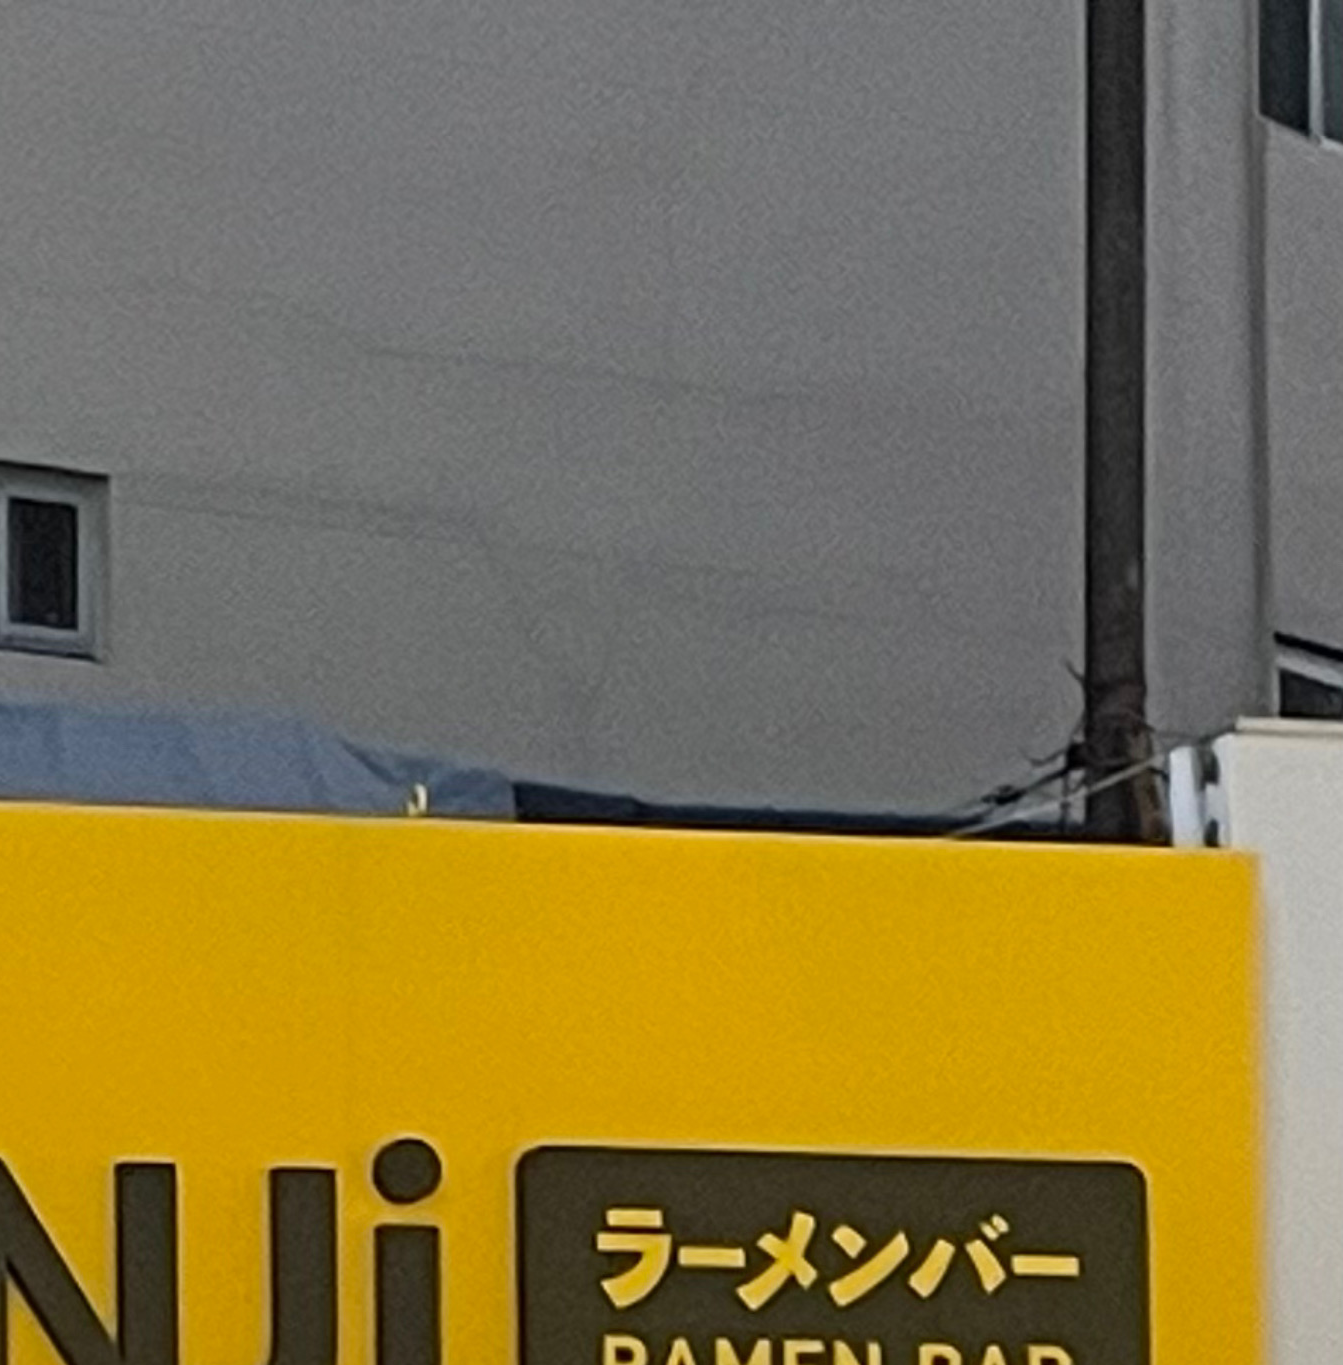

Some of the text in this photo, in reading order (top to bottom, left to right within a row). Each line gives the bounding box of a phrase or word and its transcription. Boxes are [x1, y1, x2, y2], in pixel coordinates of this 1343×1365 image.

[596, 1207, 1080, 1311] ラーメンバー
